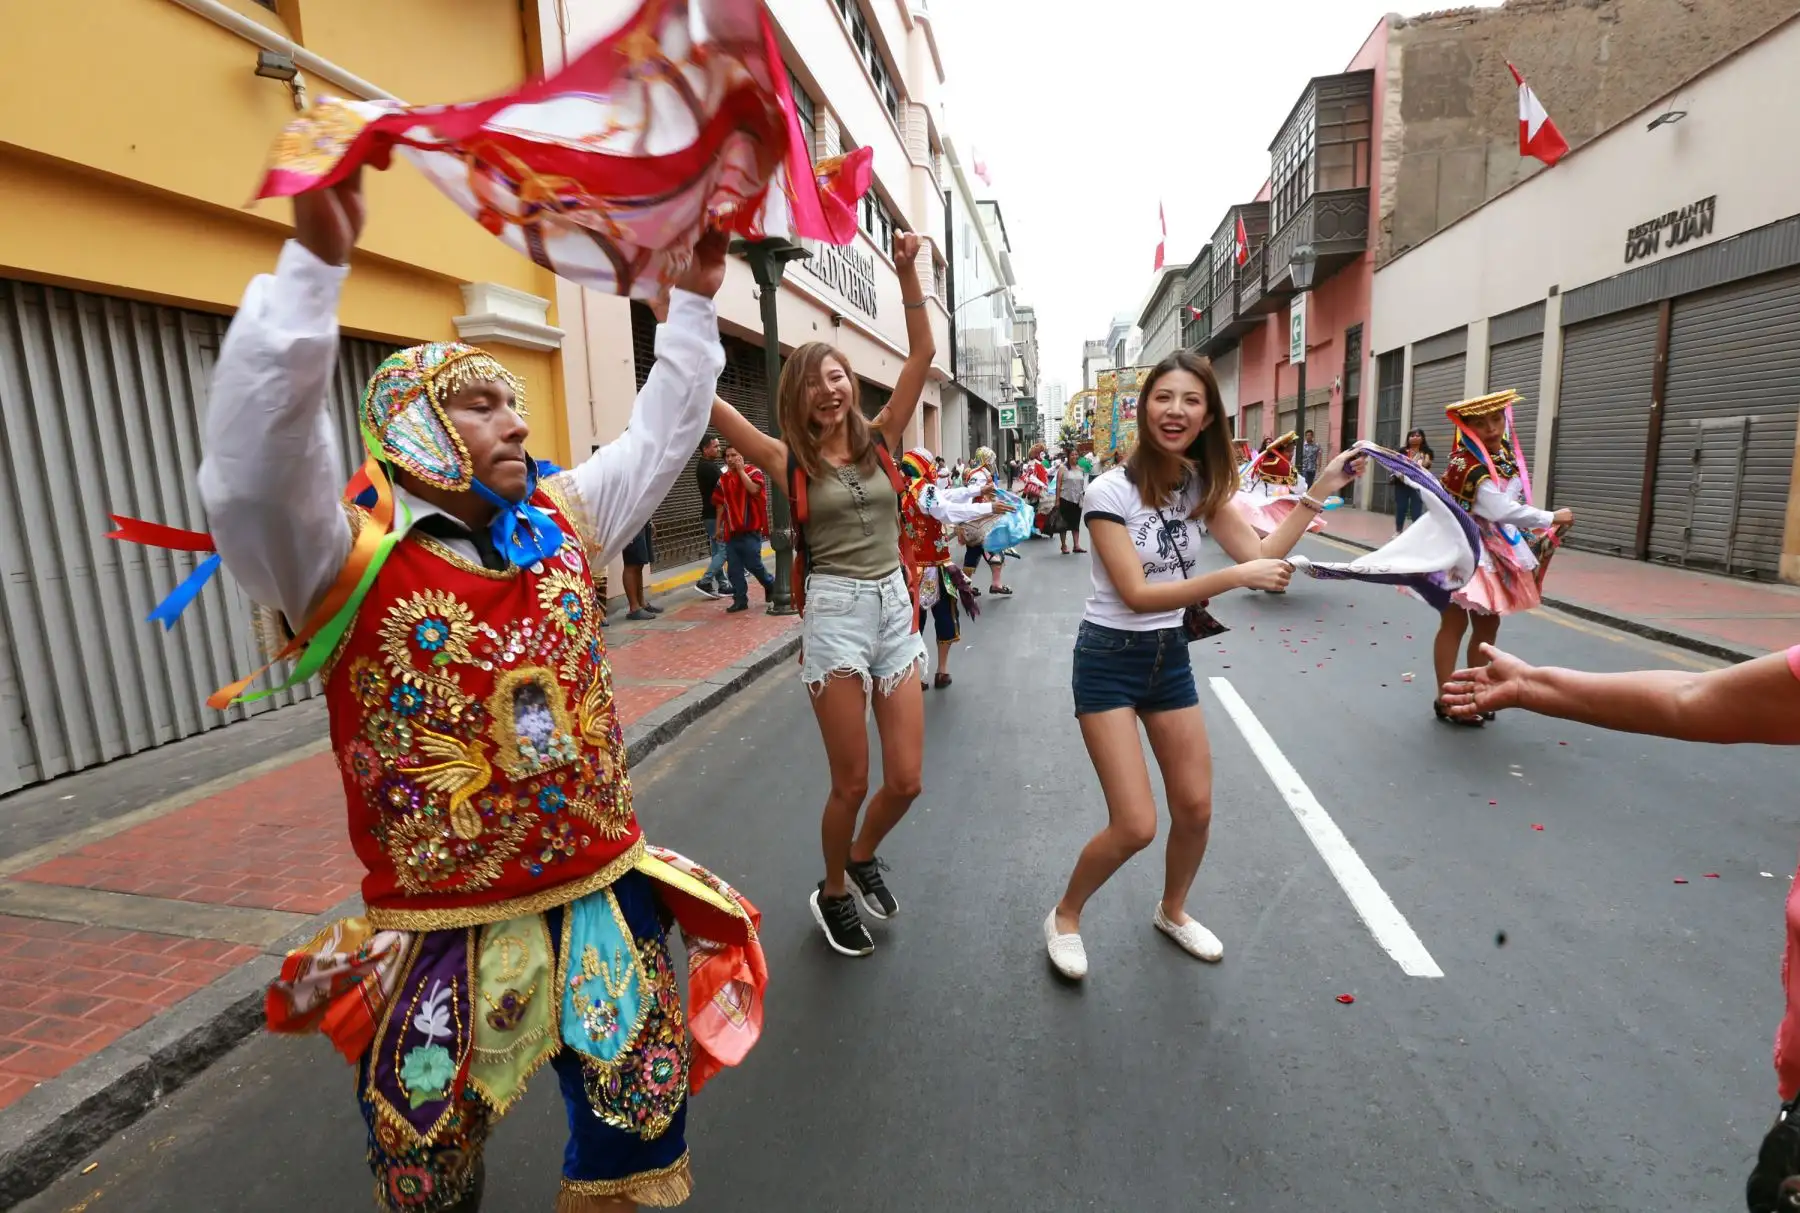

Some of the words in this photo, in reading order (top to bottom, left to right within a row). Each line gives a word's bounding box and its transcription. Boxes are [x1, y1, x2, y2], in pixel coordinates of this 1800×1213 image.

[1624, 230, 1660, 263] DON
[1665, 207, 1716, 248] JUAN
[1627, 194, 1717, 241] RESTAURANTE
